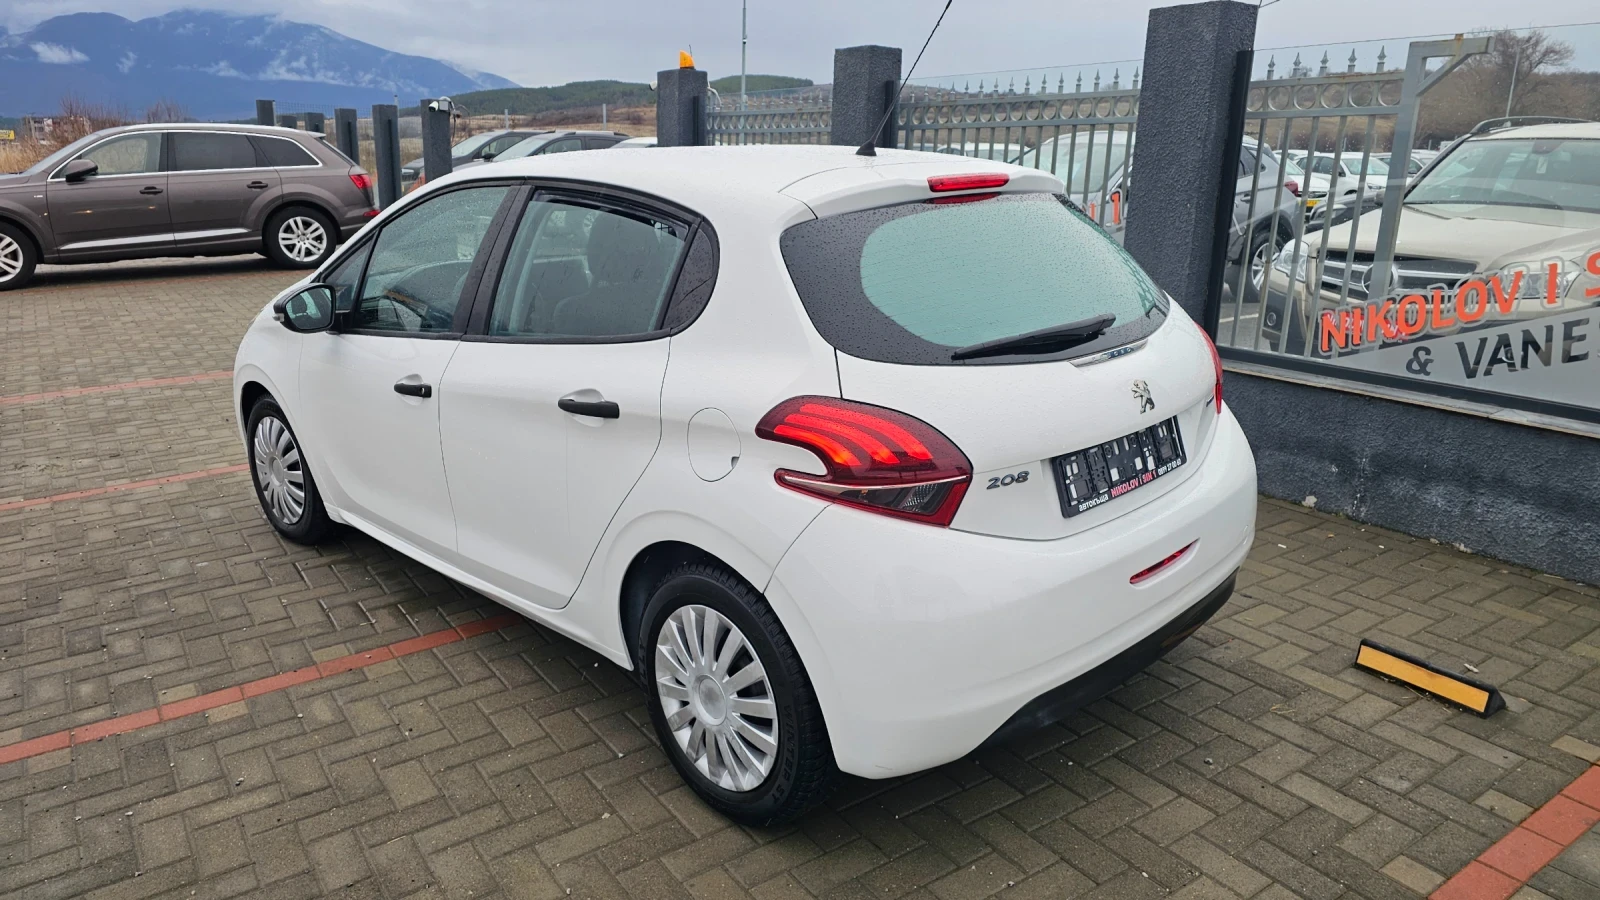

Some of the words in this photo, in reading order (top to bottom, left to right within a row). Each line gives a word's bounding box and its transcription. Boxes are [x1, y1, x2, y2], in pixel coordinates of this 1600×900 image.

[1320, 270, 1523, 353] NIKOLOV
[1406, 346, 1434, 376] &
[1455, 317, 1600, 379] VANE
[986, 470, 1030, 490] 208
[1110, 477, 1139, 498] NIKOLOV
